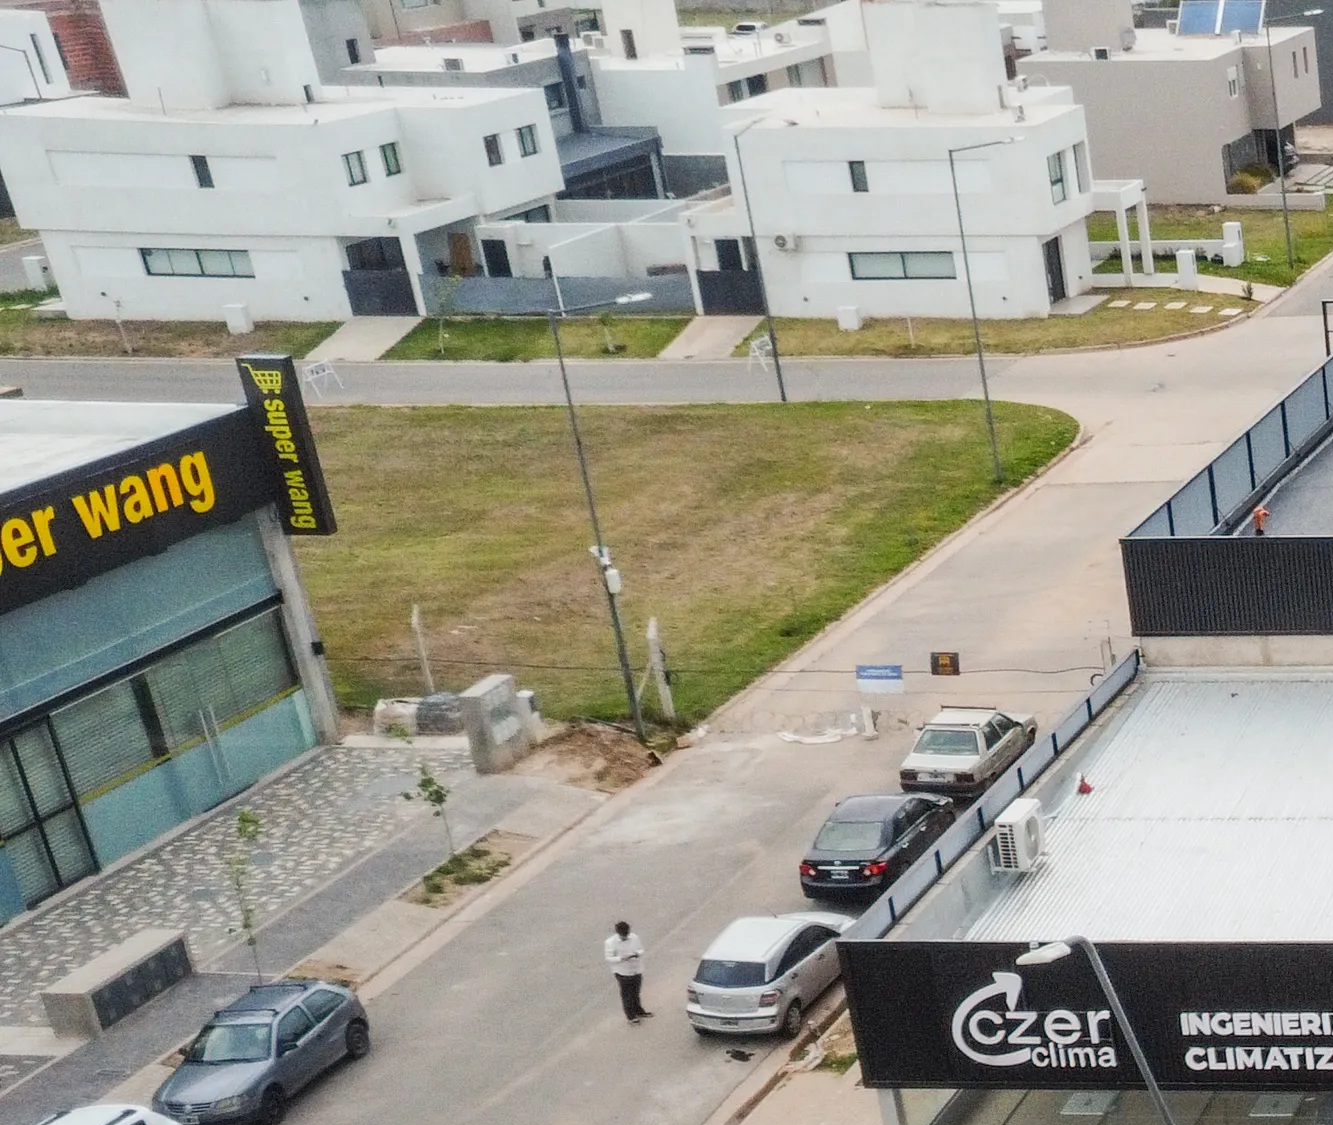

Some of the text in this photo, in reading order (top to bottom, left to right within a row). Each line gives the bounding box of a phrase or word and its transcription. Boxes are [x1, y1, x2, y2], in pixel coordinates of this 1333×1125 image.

[0, 450, 216, 578] er wang
[263, 398, 317, 530] super wang
[1030, 1042, 1118, 1068] clima
